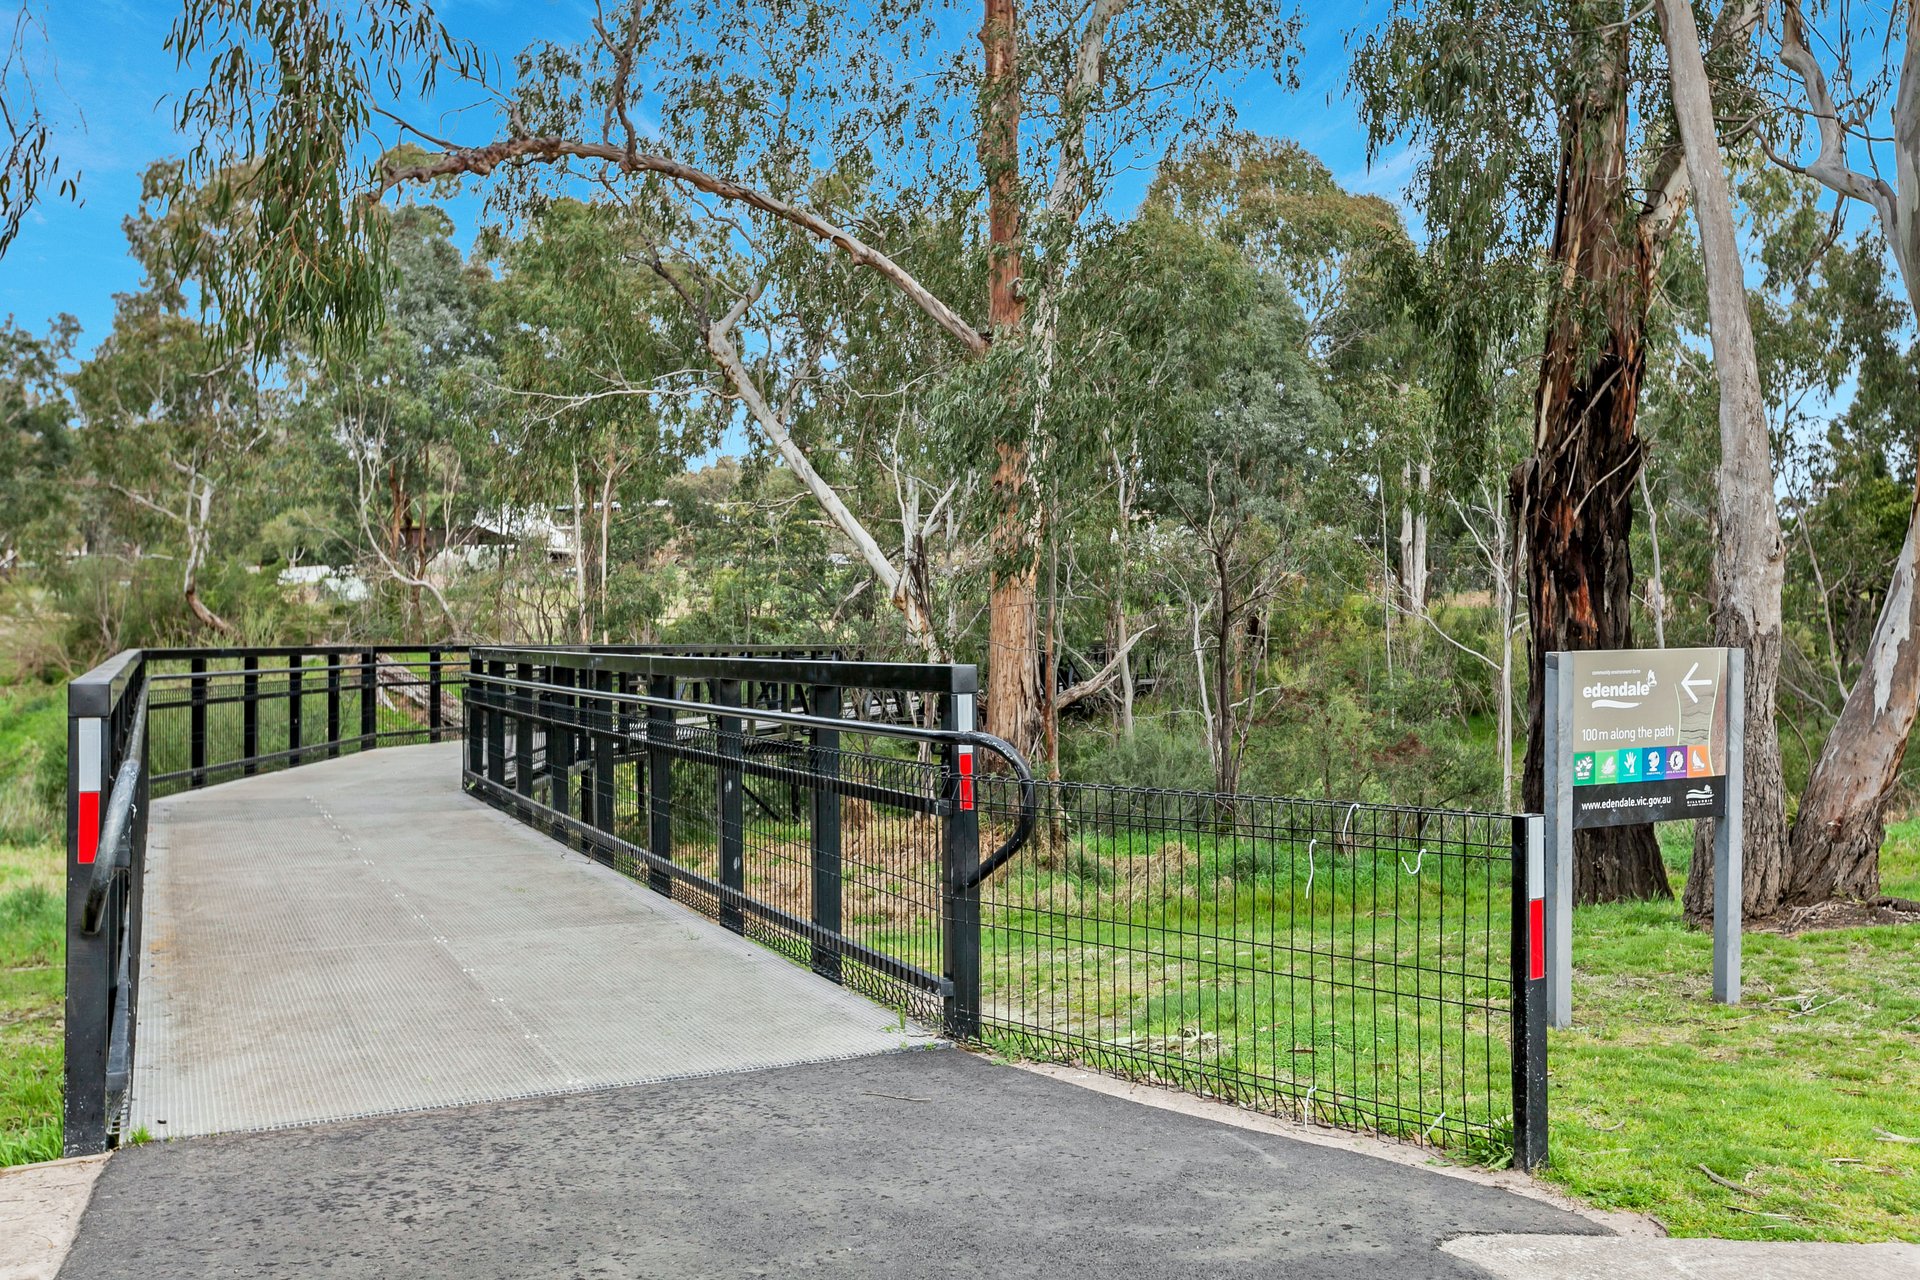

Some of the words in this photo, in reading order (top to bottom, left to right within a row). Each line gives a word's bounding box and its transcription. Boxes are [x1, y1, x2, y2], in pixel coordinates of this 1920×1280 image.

[1583, 681, 1650, 698] edendale
[1610, 727, 1636, 742] along
[1638, 726, 1653, 738] the
[1655, 724, 1675, 740] path
[1581, 796, 1672, 810] www.edendale.vic.gov.au
